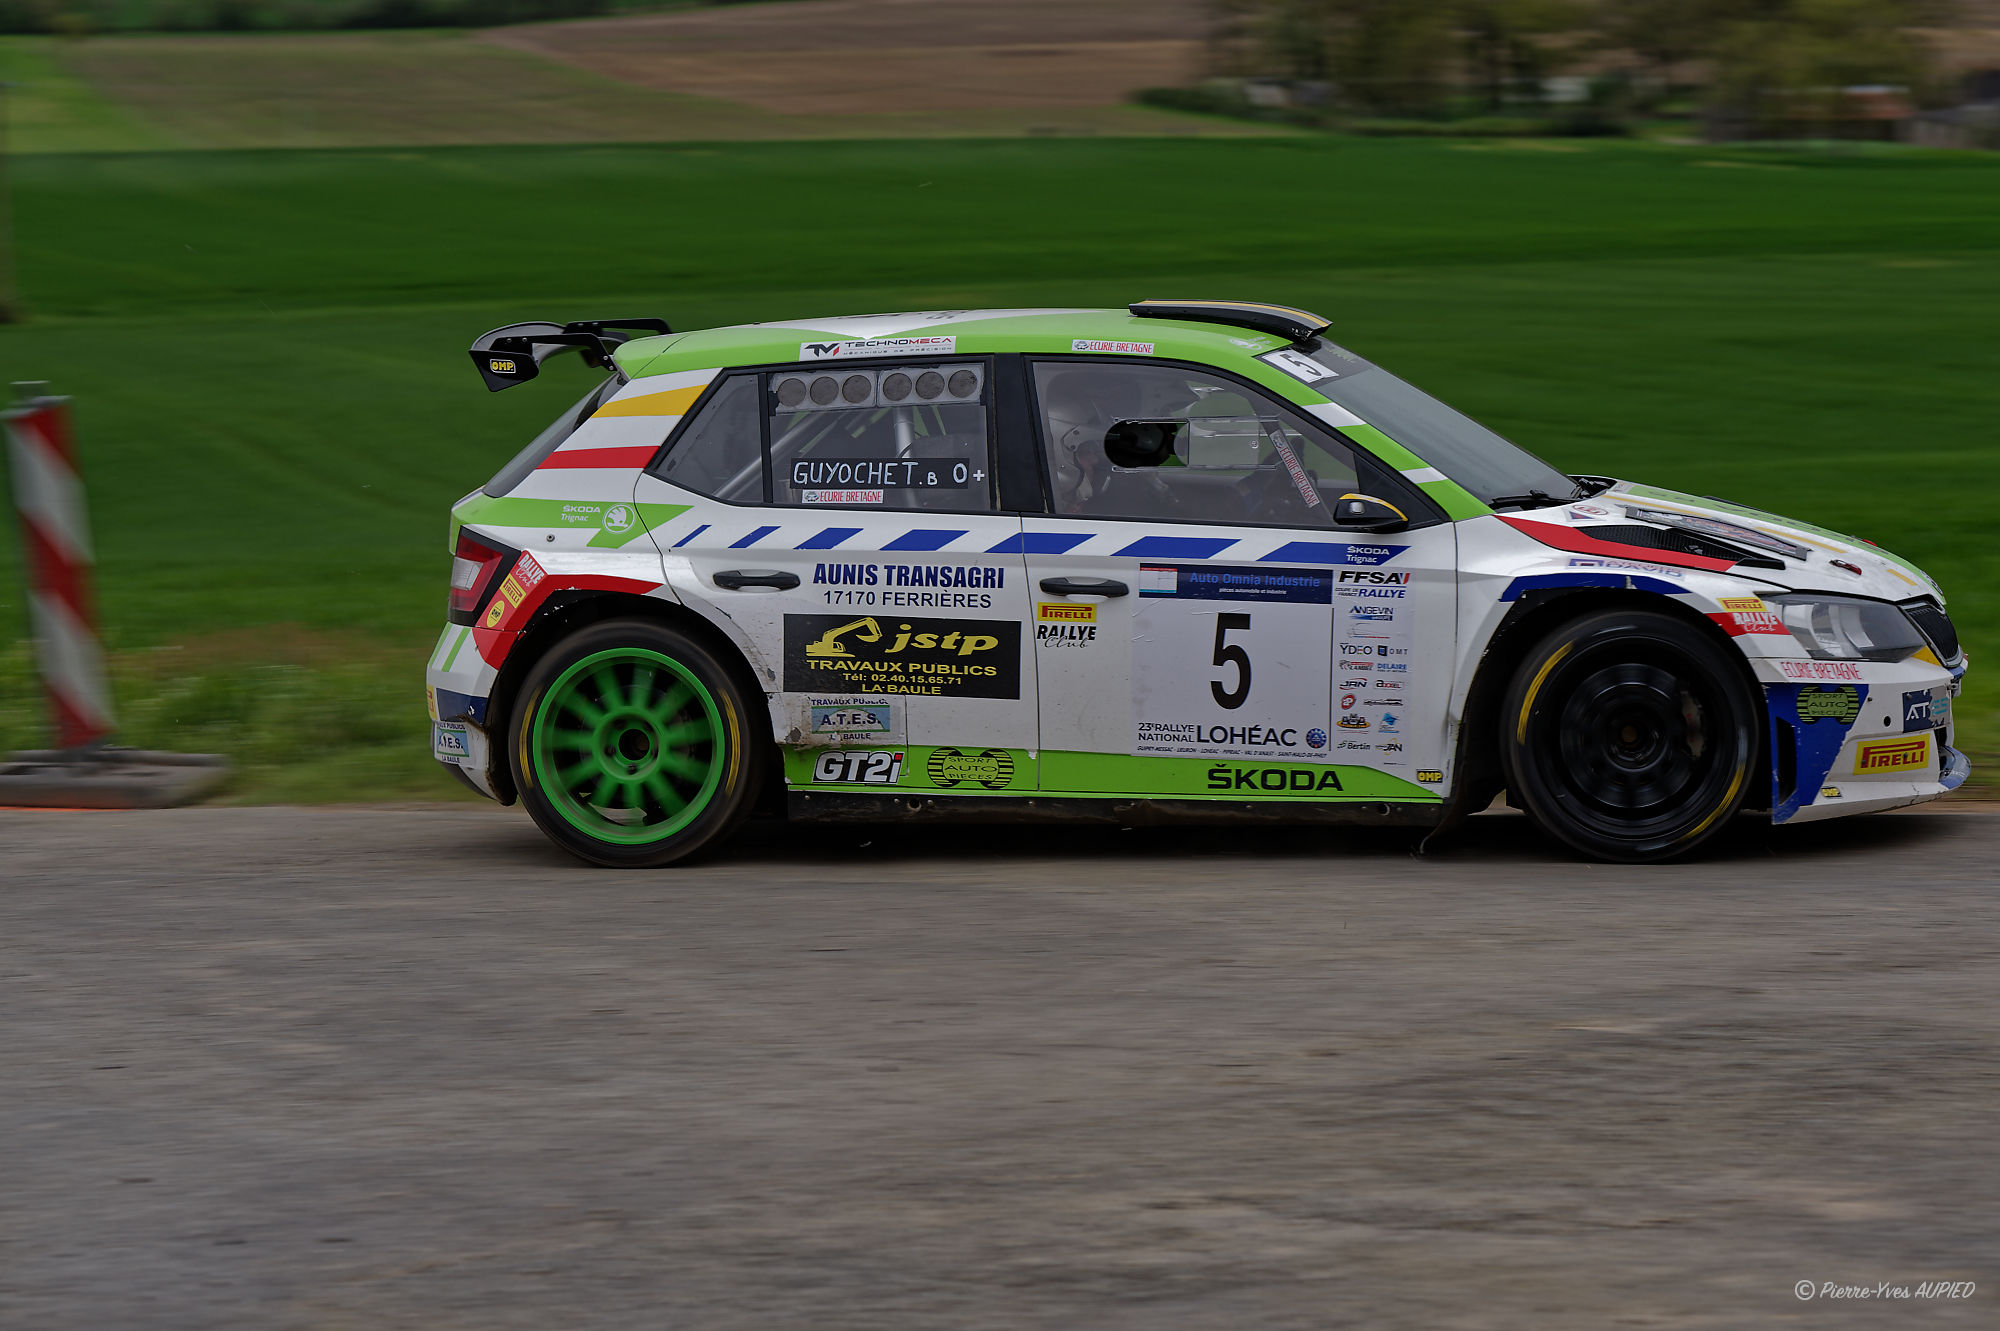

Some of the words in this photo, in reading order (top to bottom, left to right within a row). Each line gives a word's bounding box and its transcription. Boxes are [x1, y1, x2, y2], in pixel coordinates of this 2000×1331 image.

[845, 337, 952, 348] TECHNOMECA
[1090, 341, 1114, 351] ECURIE
[1116, 342, 1153, 353] BRETAGNE
[492, 361, 514, 371] OMP
[819, 491, 844, 502] ECURIE
[845, 492, 882, 502] BRETAGNE
[563, 505, 601, 513] ŠKODA
[561, 513, 589, 522] Trignac
[1347, 545, 1390, 555] ŠKODA
[1346, 554, 1378, 564] Trignac
[518, 554, 544, 584] RALLYE
[813, 563, 878, 585] AUNIS
[884, 565, 1005, 589] TRANSAGRI
[1189, 572, 1219, 584] Auto
[1222, 573, 1261, 586] Omnia
[1265, 575, 1321, 588] Industrie
[1339, 570, 1402, 584] FFSA
[823, 591, 876, 605] 17170
[882, 589, 992, 608] FERRIÈRES
[1359, 588, 1407, 599] RALLYE
[1722, 599, 1763, 609] PIRELLI
[1042, 605, 1093, 619] PIRELLI
[1732, 612, 1778, 625] RALLYE
[1037, 625, 1097, 640] RALLYE
[884, 623, 999, 656] jstp
[1211, 612, 1252, 709] 5
[807, 659, 903, 672] TRAVAUX
[909, 663, 998, 676] PUBLICS
[1780, 661, 1815, 678] ECURIE
[1813, 662, 1862, 680] BRETAGNE
[871, 674, 962, 685] 02.40.15.65.71
[862, 683, 883, 693] LA
[887, 684, 942, 695] BAULE
[1155, 723, 1195, 733] RALLYE
[1138, 733, 1195, 743] NATIONAL
[1197, 725, 1297, 747] LOHÉAC
[1860, 740, 1926, 769] PIRELLI
[815, 752, 904, 783] GT2i
[944, 764, 998, 773] AUTO
[1208, 763, 1344, 792] ŠKODA
[1417, 772, 1443, 782] OMP
